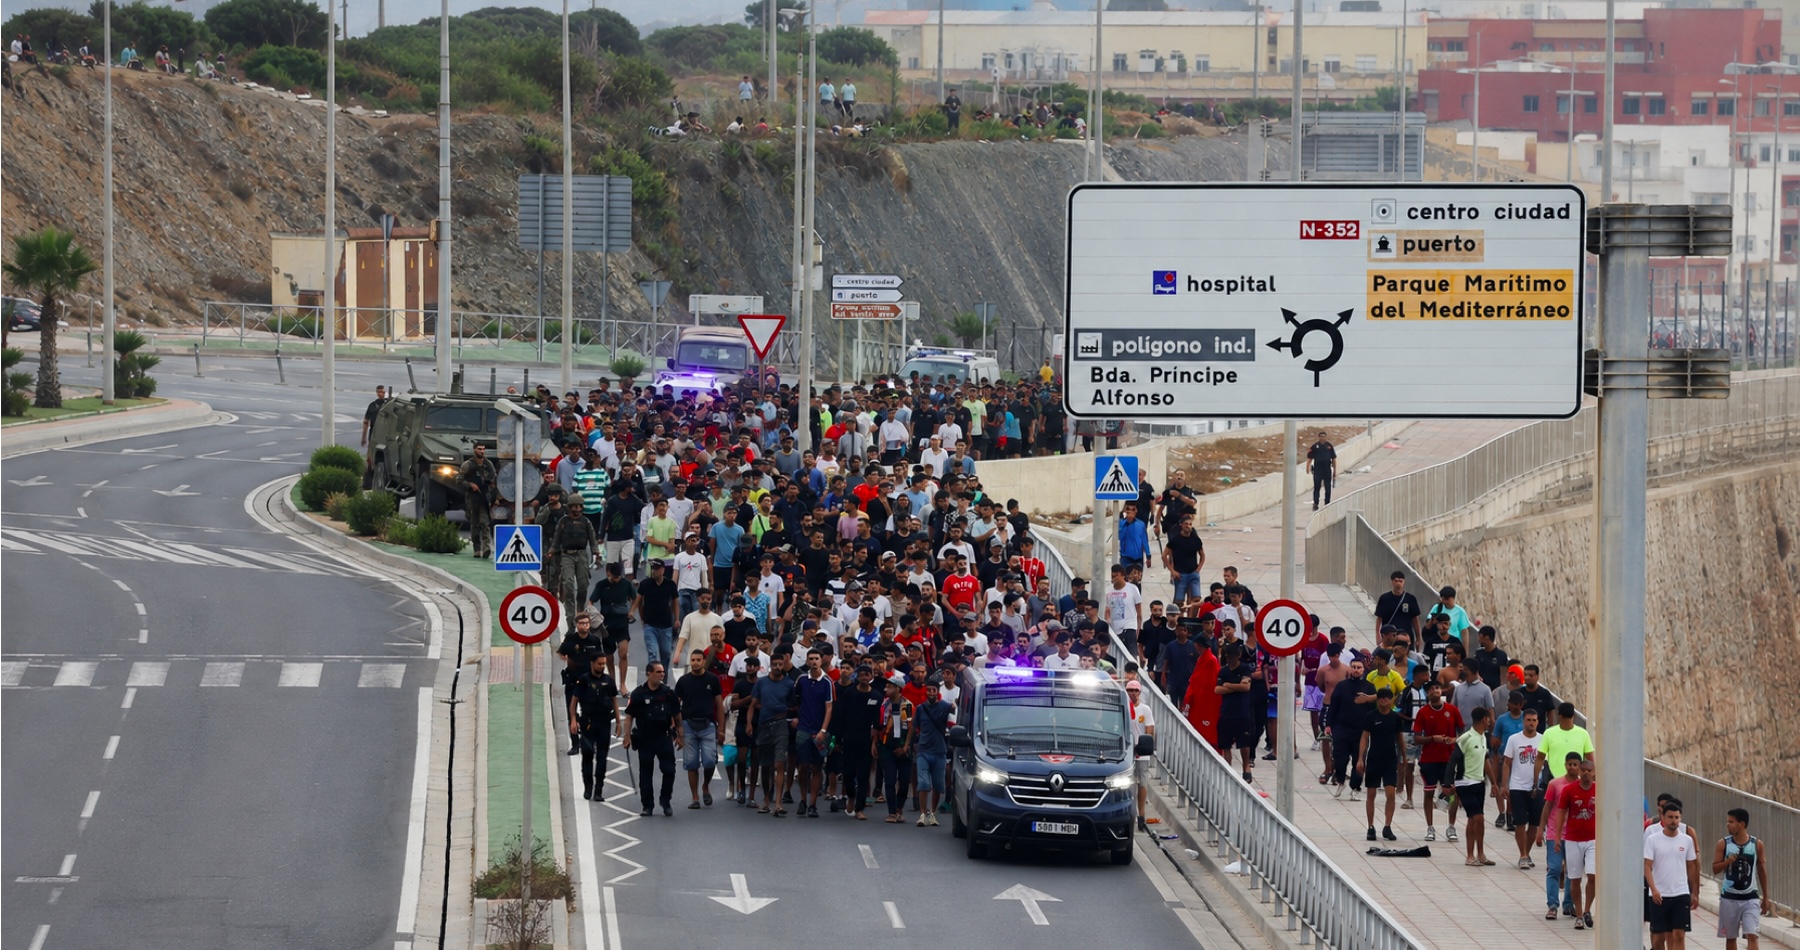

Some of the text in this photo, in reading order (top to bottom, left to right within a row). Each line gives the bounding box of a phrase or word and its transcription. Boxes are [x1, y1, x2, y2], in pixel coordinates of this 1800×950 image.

[1407, 203, 1571, 220] centro ciudad
[1302, 222, 1357, 238] N-352
[1403, 234, 1476, 254] puerto
[1187, 275, 1276, 295] hospital
[1373, 274, 1567, 294] Parque Marítimo
[1370, 301, 1570, 318] del Mediterráneo
[1112, 336, 1252, 357] polígono ind.
[1091, 366, 1238, 387] Bda. Príncipe
[1091, 388, 1175, 406] Alfonso
[511, 605, 547, 624] 40
[1266, 618, 1301, 637] 40
